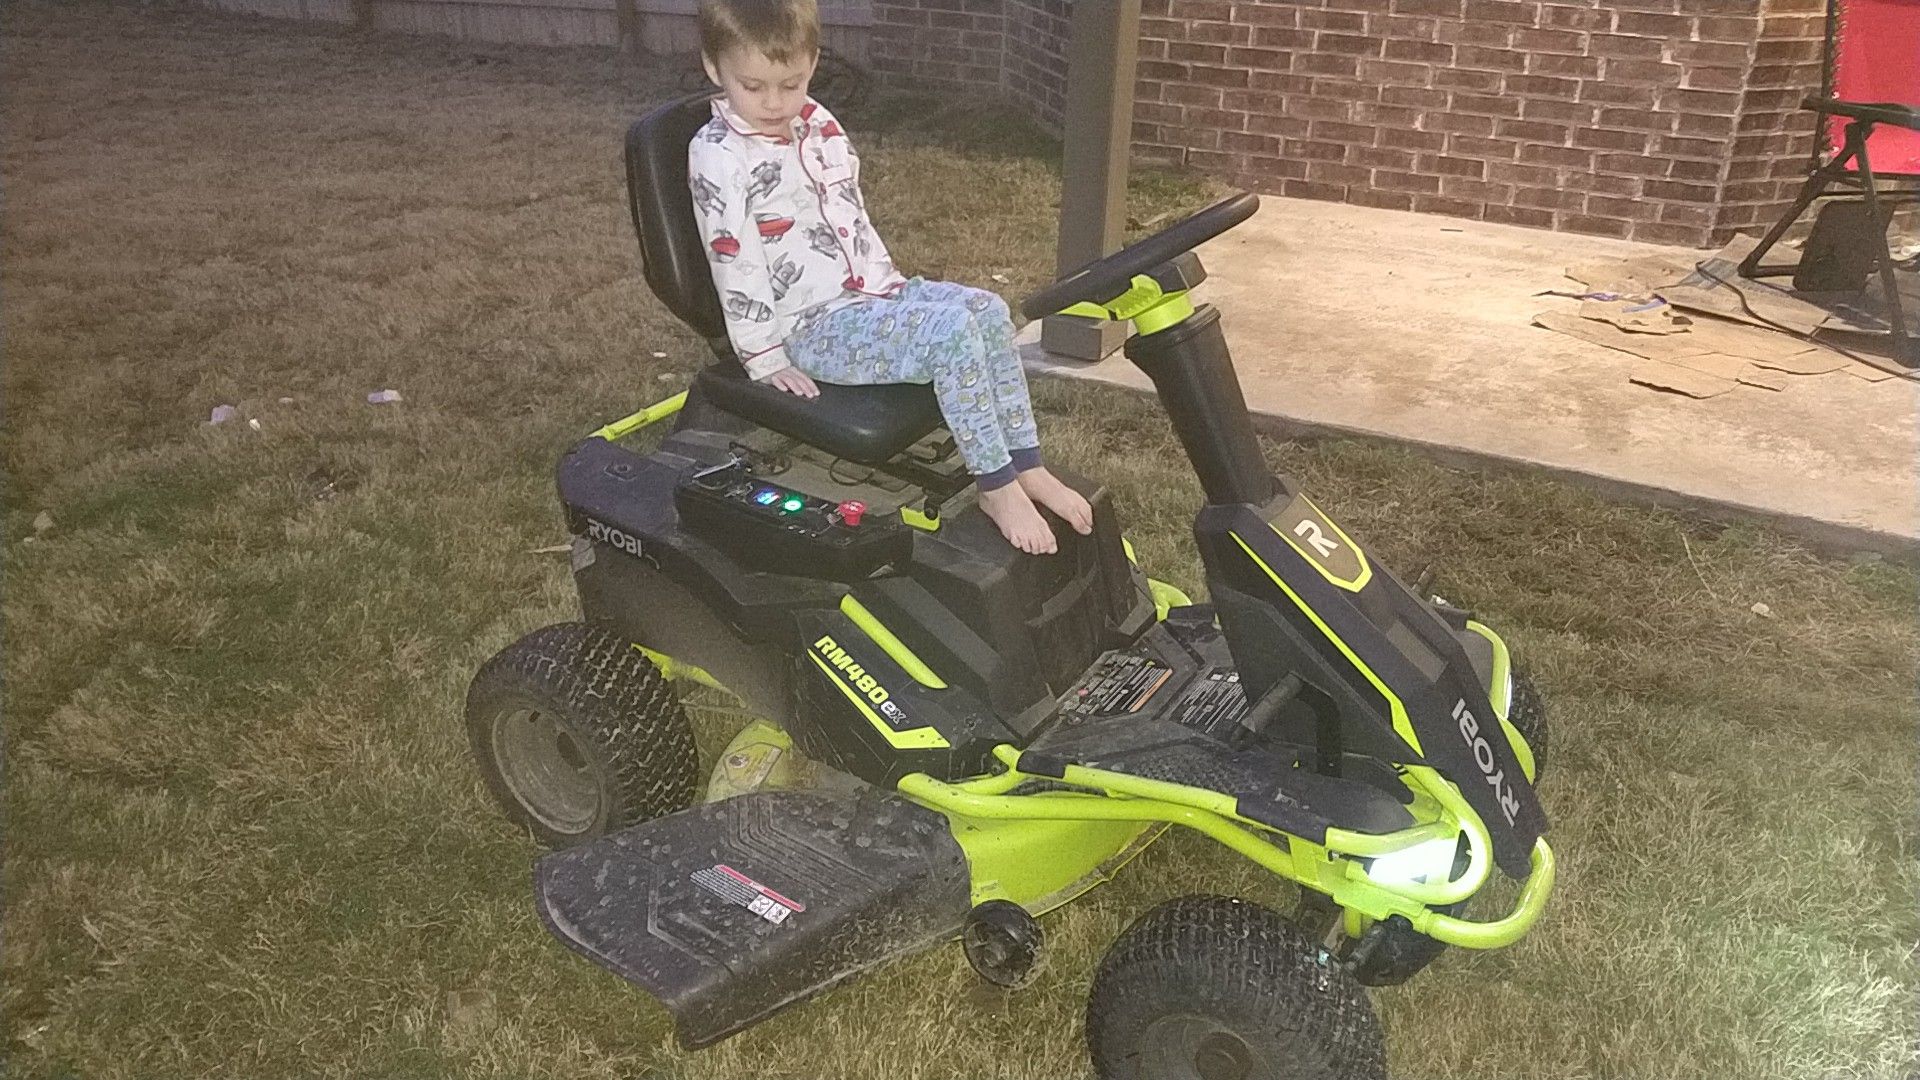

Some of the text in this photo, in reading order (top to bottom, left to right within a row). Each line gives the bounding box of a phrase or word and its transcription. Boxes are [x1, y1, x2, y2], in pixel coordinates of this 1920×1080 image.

[587, 518, 642, 557] RYOBI
[1293, 519, 1339, 558] R
[1451, 698, 1520, 827] RYOBI
